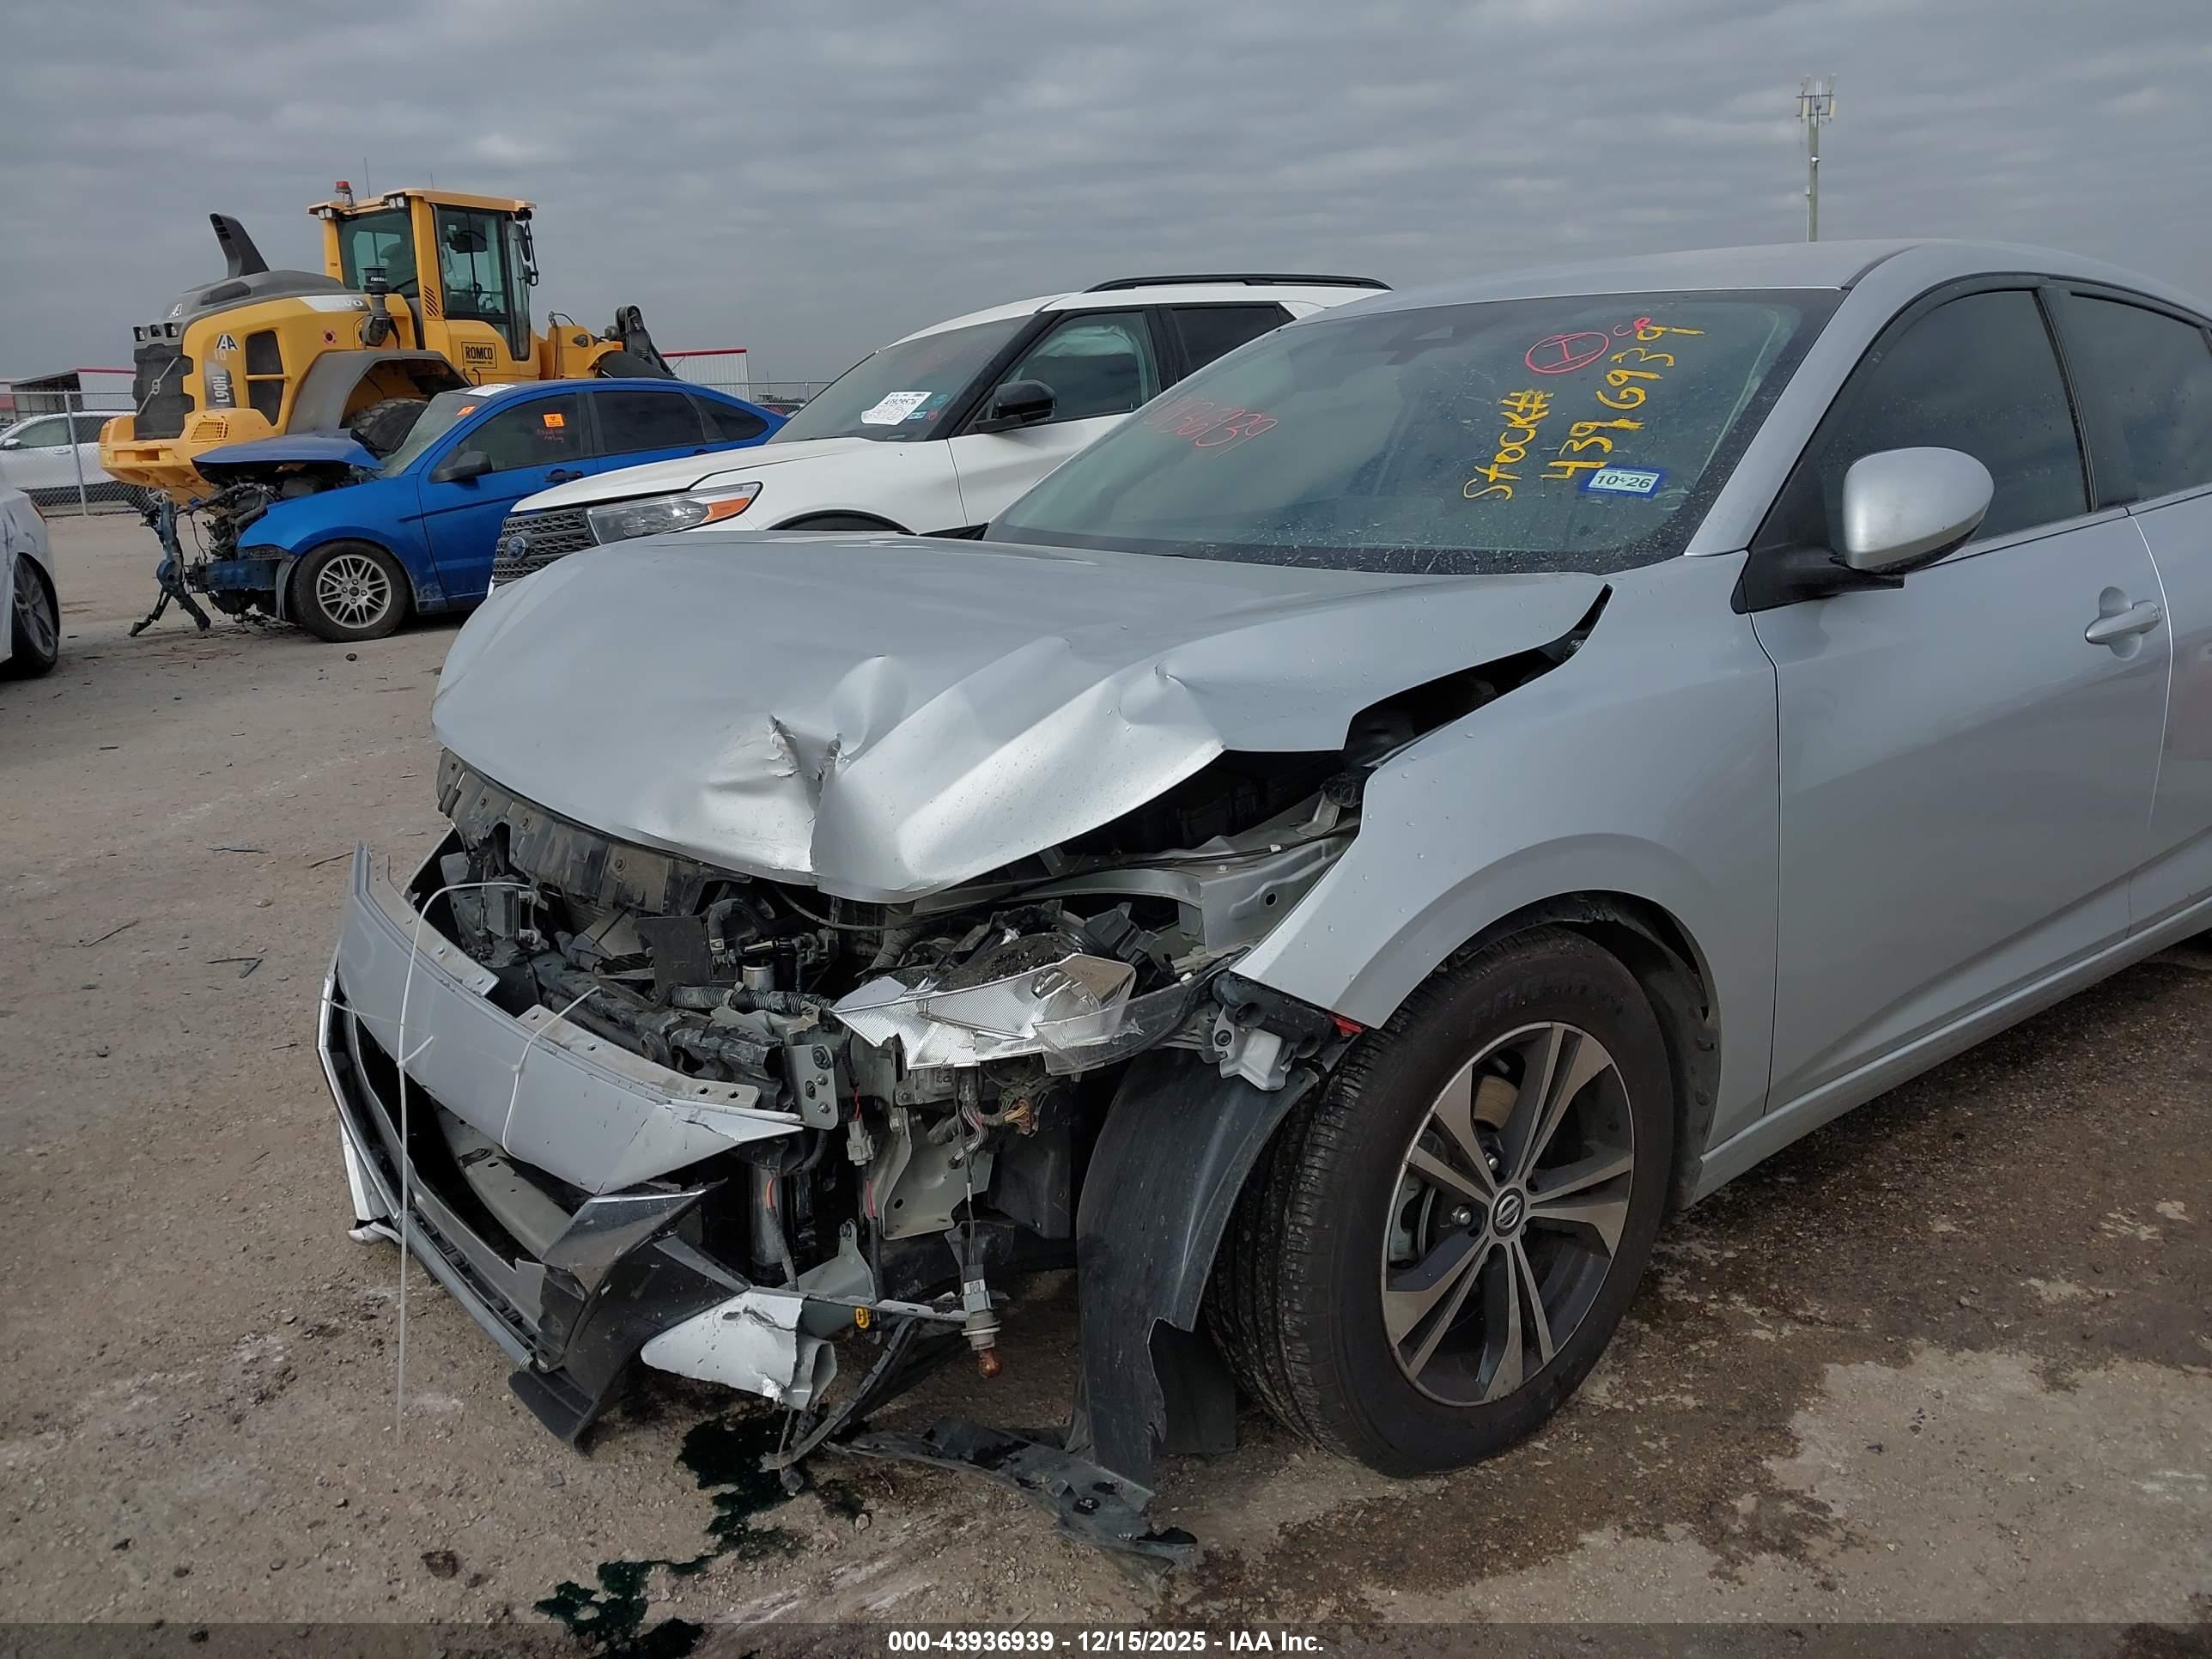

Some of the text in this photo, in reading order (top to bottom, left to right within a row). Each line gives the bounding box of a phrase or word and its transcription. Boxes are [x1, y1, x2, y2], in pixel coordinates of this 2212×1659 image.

[465, 346, 494, 360] ROMCO
[212, 375, 231, 404] L90H
[1597, 475, 1652, 489] 10 26
